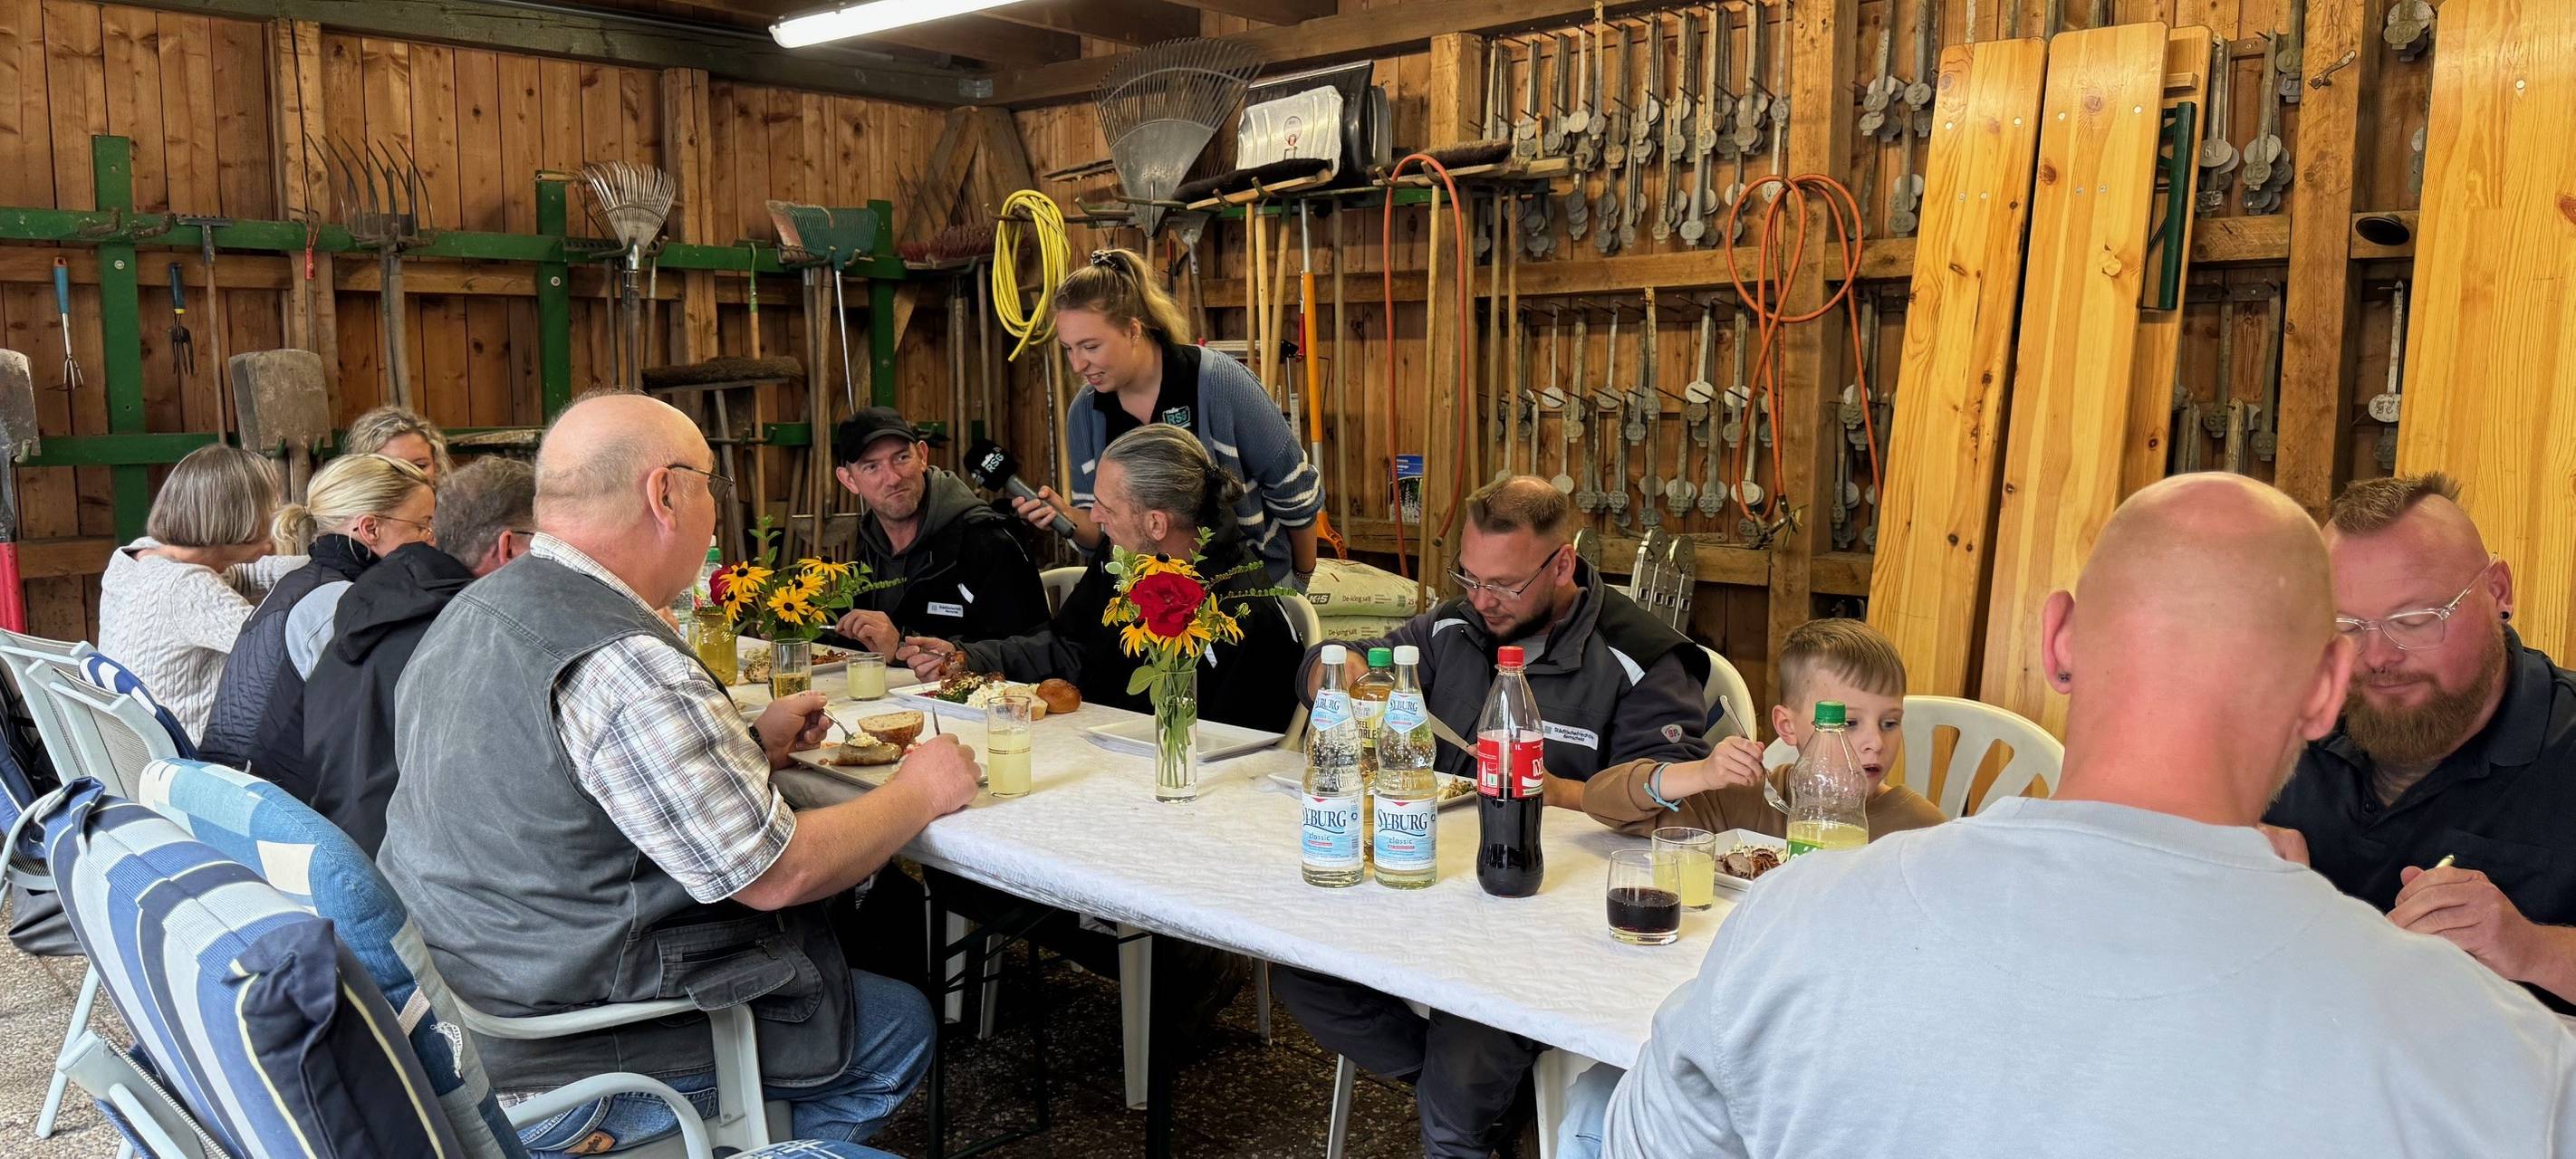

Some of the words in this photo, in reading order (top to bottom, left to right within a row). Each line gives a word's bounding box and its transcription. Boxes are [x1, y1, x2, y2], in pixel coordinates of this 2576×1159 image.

[1167, 410, 1187, 424] RSG
[985, 453, 1004, 473] RSG
[1310, 595, 1329, 603] K+S
[1378, 809, 1427, 830] SYBURG
